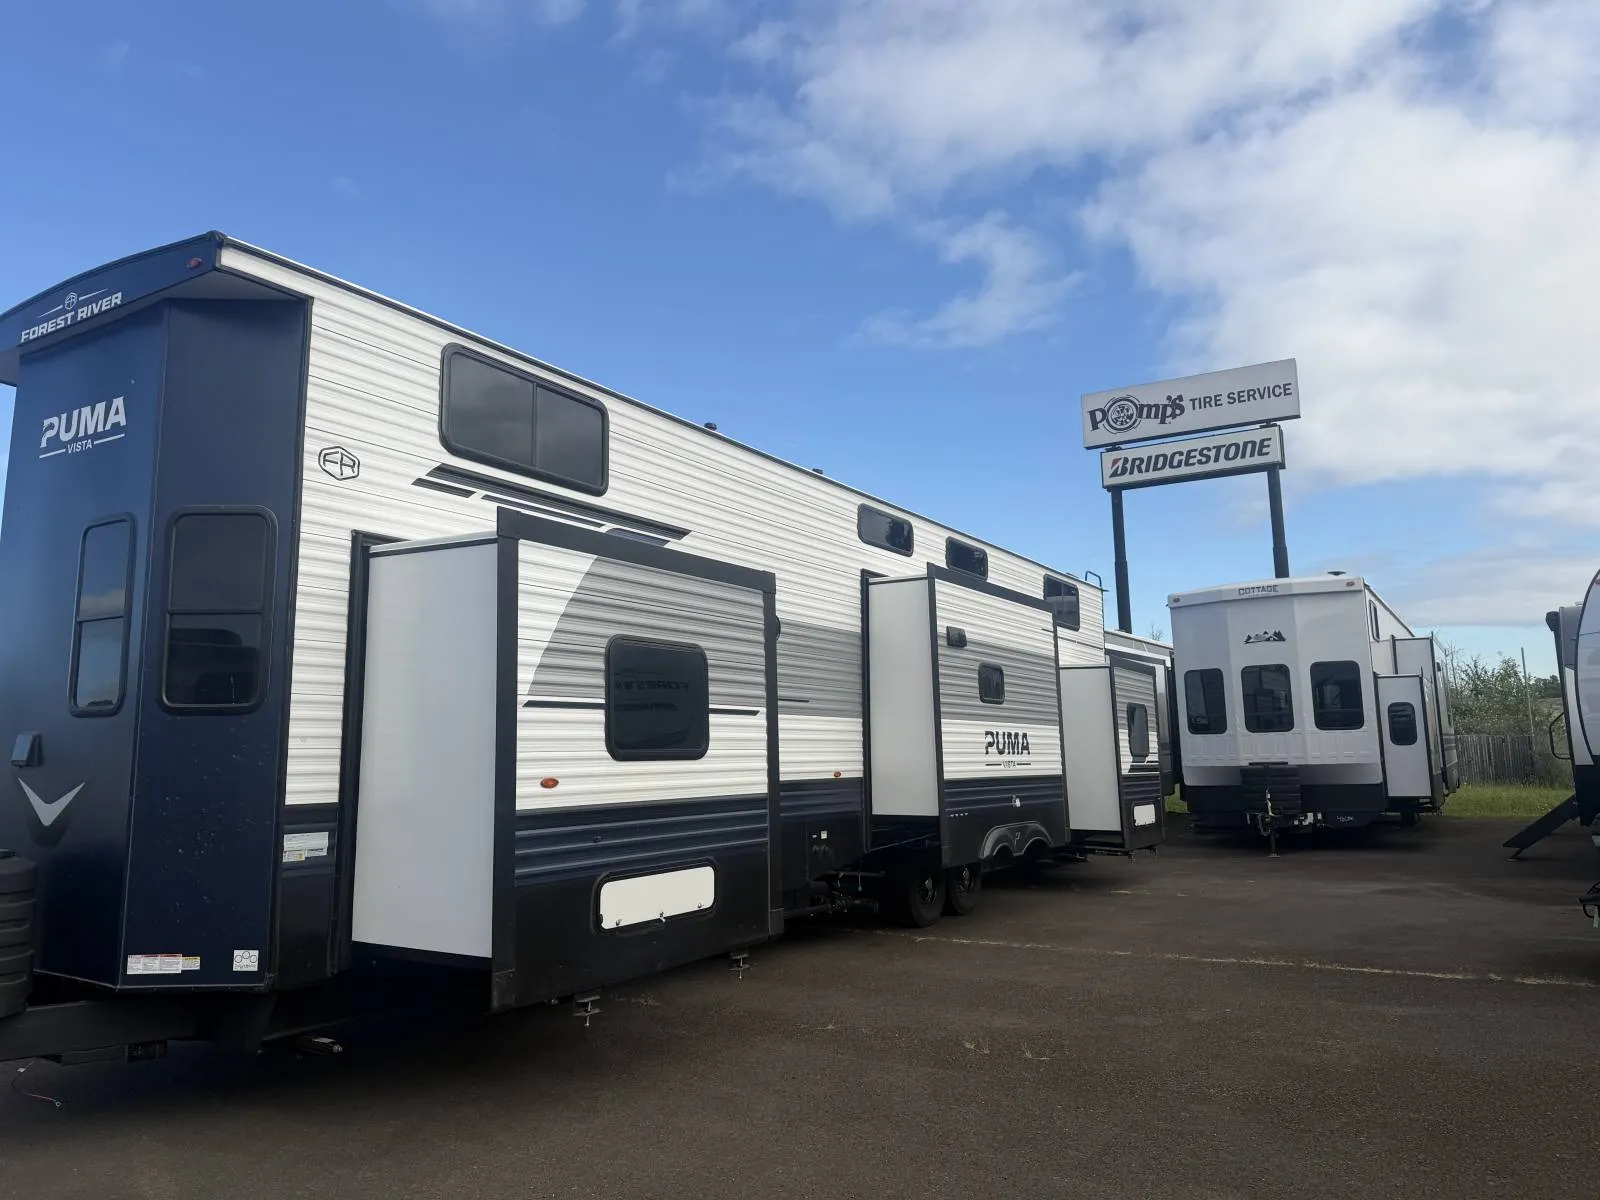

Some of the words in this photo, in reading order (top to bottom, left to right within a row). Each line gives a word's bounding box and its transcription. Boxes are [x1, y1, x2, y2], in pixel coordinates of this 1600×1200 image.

[20, 311, 75, 343] FOREST
[77, 291, 122, 321] RIVER
[1189, 394, 1223, 411] TIRE
[1227, 382, 1292, 405] SERVICE
[40, 396, 127, 449] PUMA
[67, 439, 93, 454] VISTA
[1108, 437, 1272, 479] BRIDGESTONE
[1238, 584, 1279, 596] COTTAGE
[984, 731, 1031, 755] PUMA
